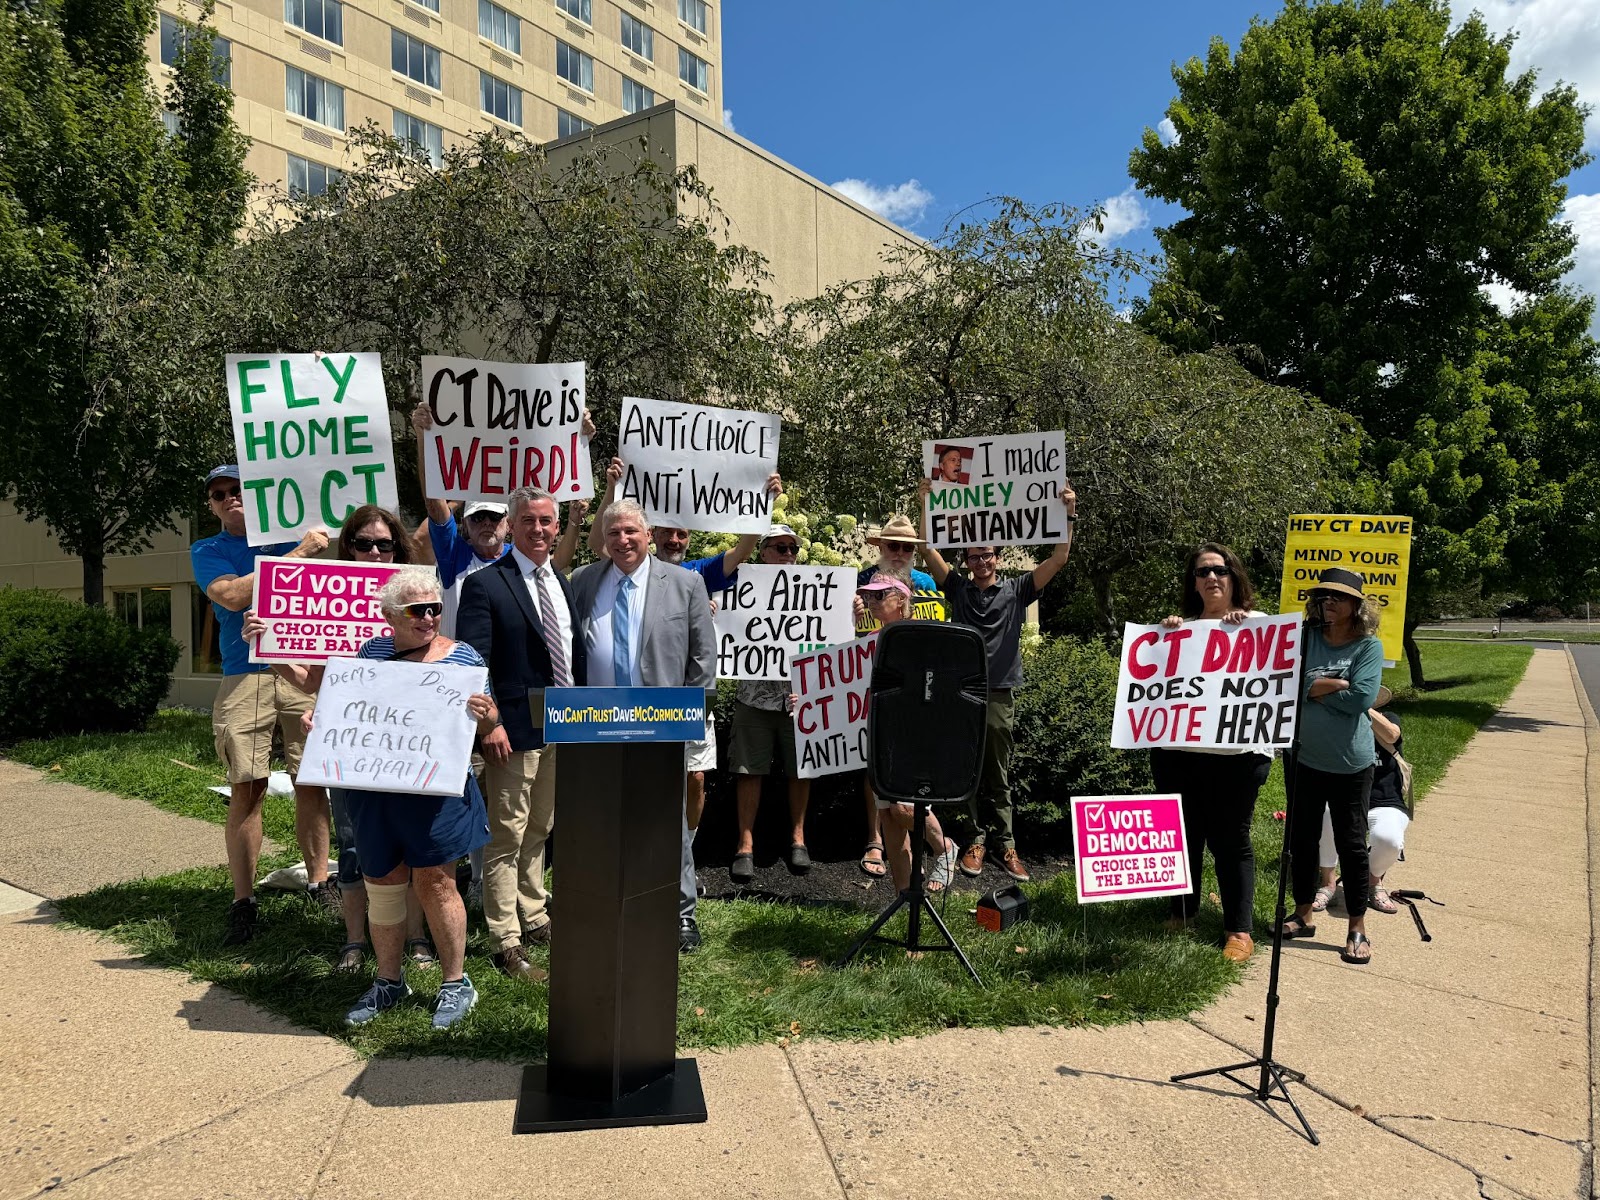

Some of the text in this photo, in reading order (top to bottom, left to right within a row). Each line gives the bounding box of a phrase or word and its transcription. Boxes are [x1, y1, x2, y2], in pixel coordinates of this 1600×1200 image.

[237, 355, 357, 413] FLY
[428, 367, 580, 430] CT Dave is
[243, 415, 373, 461] HOME
[978, 440, 1060, 478] I made
[243, 463, 386, 533] TO CT
[929, 480, 1058, 511] MONEY on
[931, 506, 1061, 544] FENTANYL
[1289, 519, 1410, 534] HEY CT DAVE
[1294, 549, 1399, 565] MIND YOUR
[309, 574, 379, 596] VOTE
[720, 569, 838, 611] He Ain't
[1294, 569, 1397, 586] OW AMN
[269, 595, 385, 619] DEMOCR
[273, 622, 395, 638] CHOICE IS O
[276, 637, 317, 650] THE
[745, 614, 827, 642] even
[717, 634, 788, 676] from
[1127, 622, 1297, 680] CT DAVE
[793, 639, 876, 696] TRUM
[1127, 671, 1294, 703] DOES NOT
[343, 700, 416, 727] MAKE
[797, 695, 834, 735] CT
[1127, 700, 1295, 744] VOTE HERE
[323, 727, 432, 758] AMERICA
[354, 757, 413, 782] GREAT
[1108, 809, 1154, 830] VOTE
[1086, 830, 1176, 854] DEMOCRAT
[1092, 856, 1176, 873] CHOICE IS ON
[1096, 870, 1175, 887] THE BALLOT
